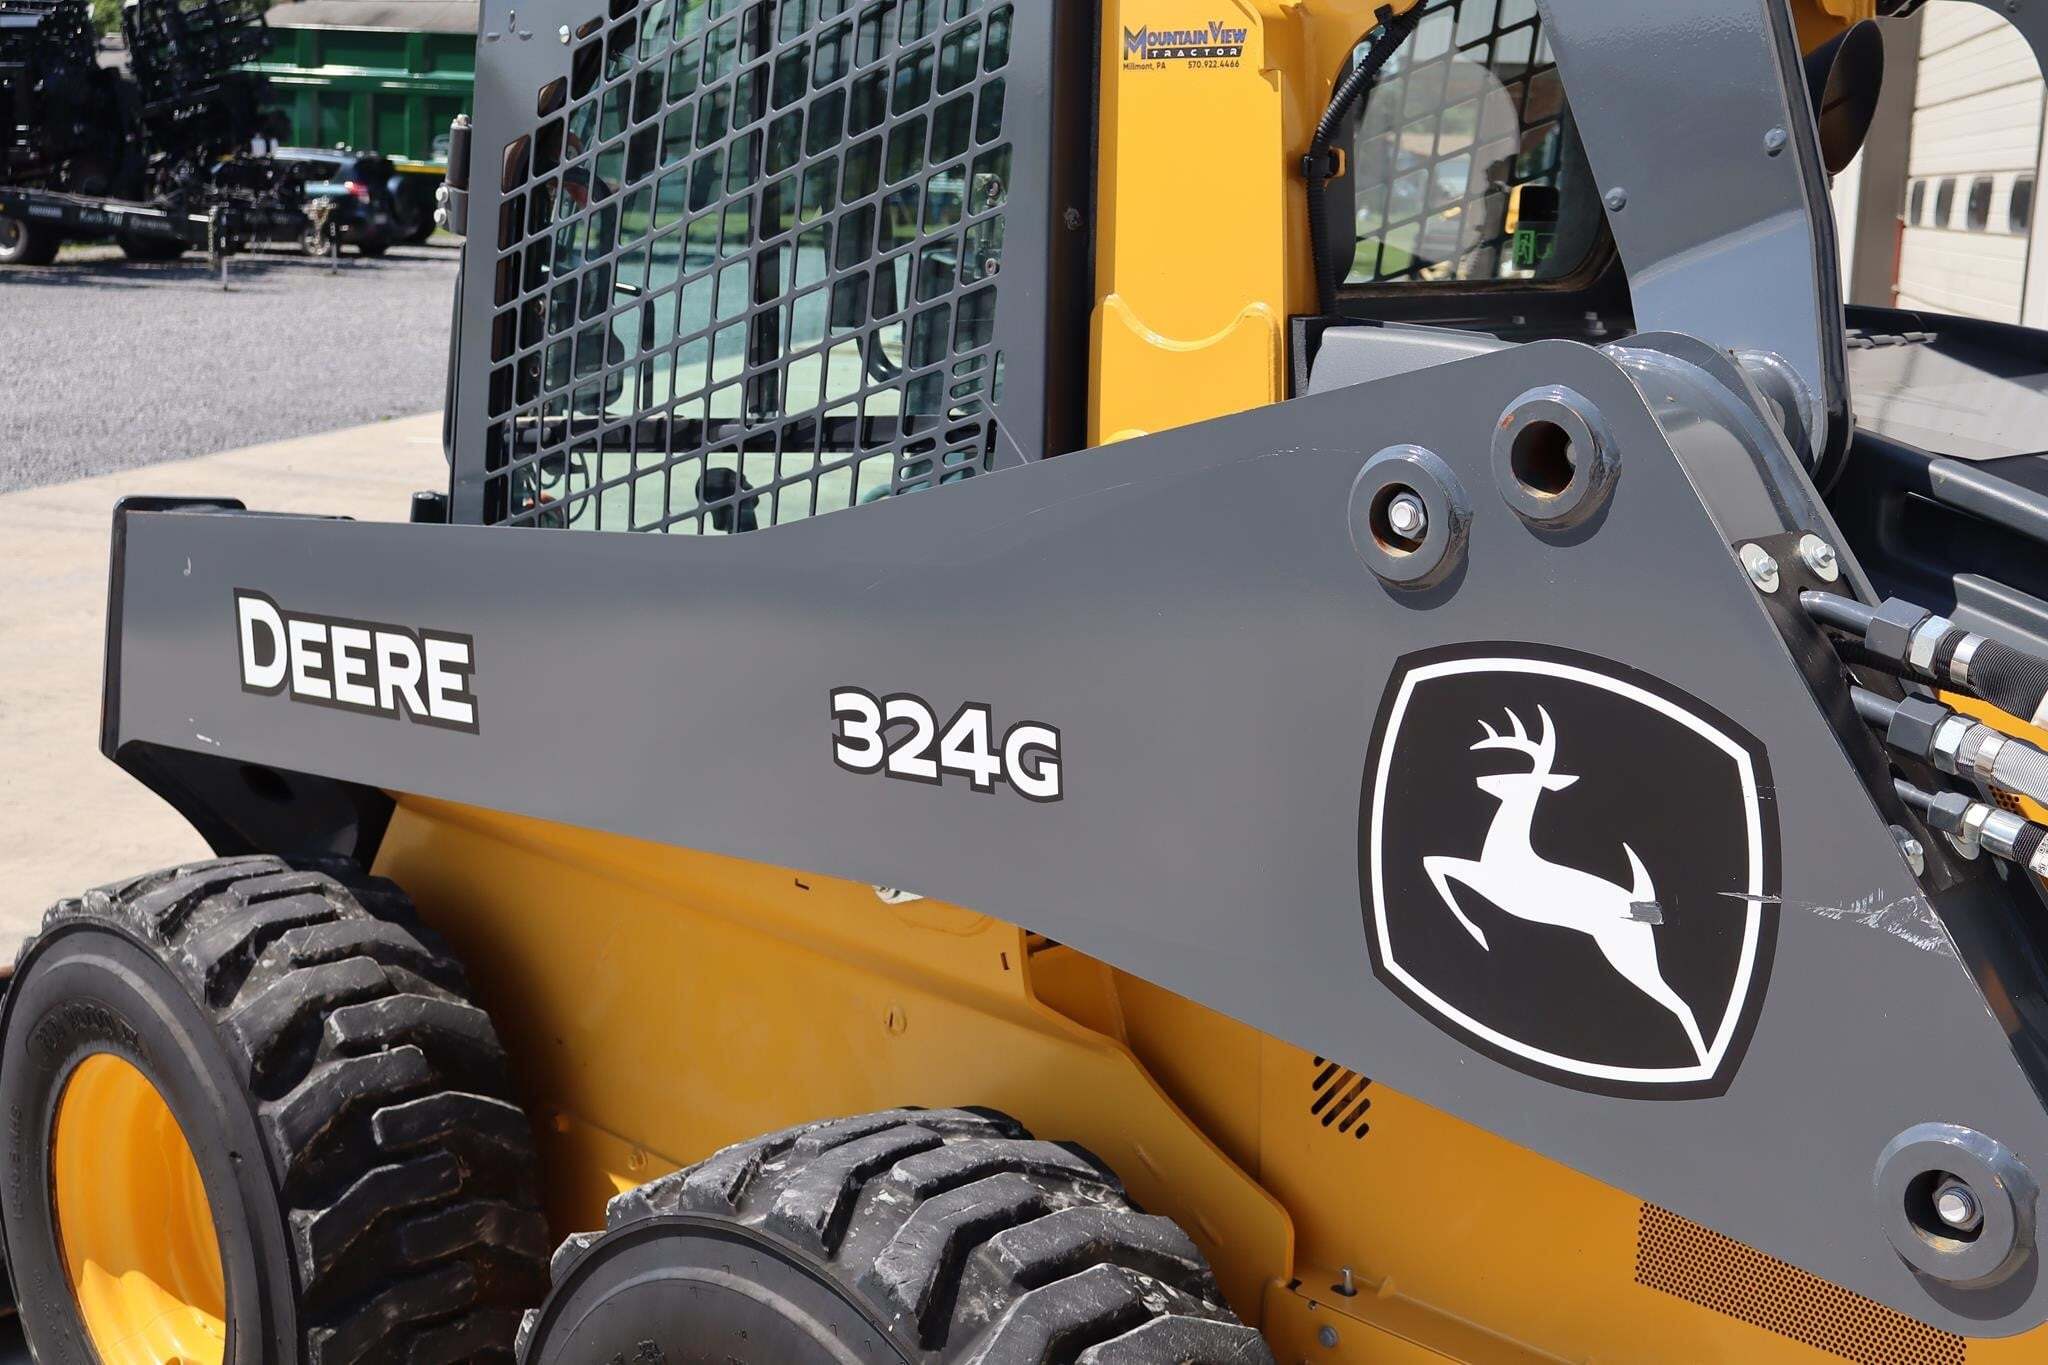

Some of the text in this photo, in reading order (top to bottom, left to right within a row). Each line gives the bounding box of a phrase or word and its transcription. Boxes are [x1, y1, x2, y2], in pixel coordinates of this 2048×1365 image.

[1151, 48, 1237, 57] TRACTOR
[1123, 61, 1166, 71] Millmont, PA
[1188, 60, 1240, 69] 570.922.4466
[238, 597, 473, 723] DEERE
[833, 692, 1061, 798] 324G
